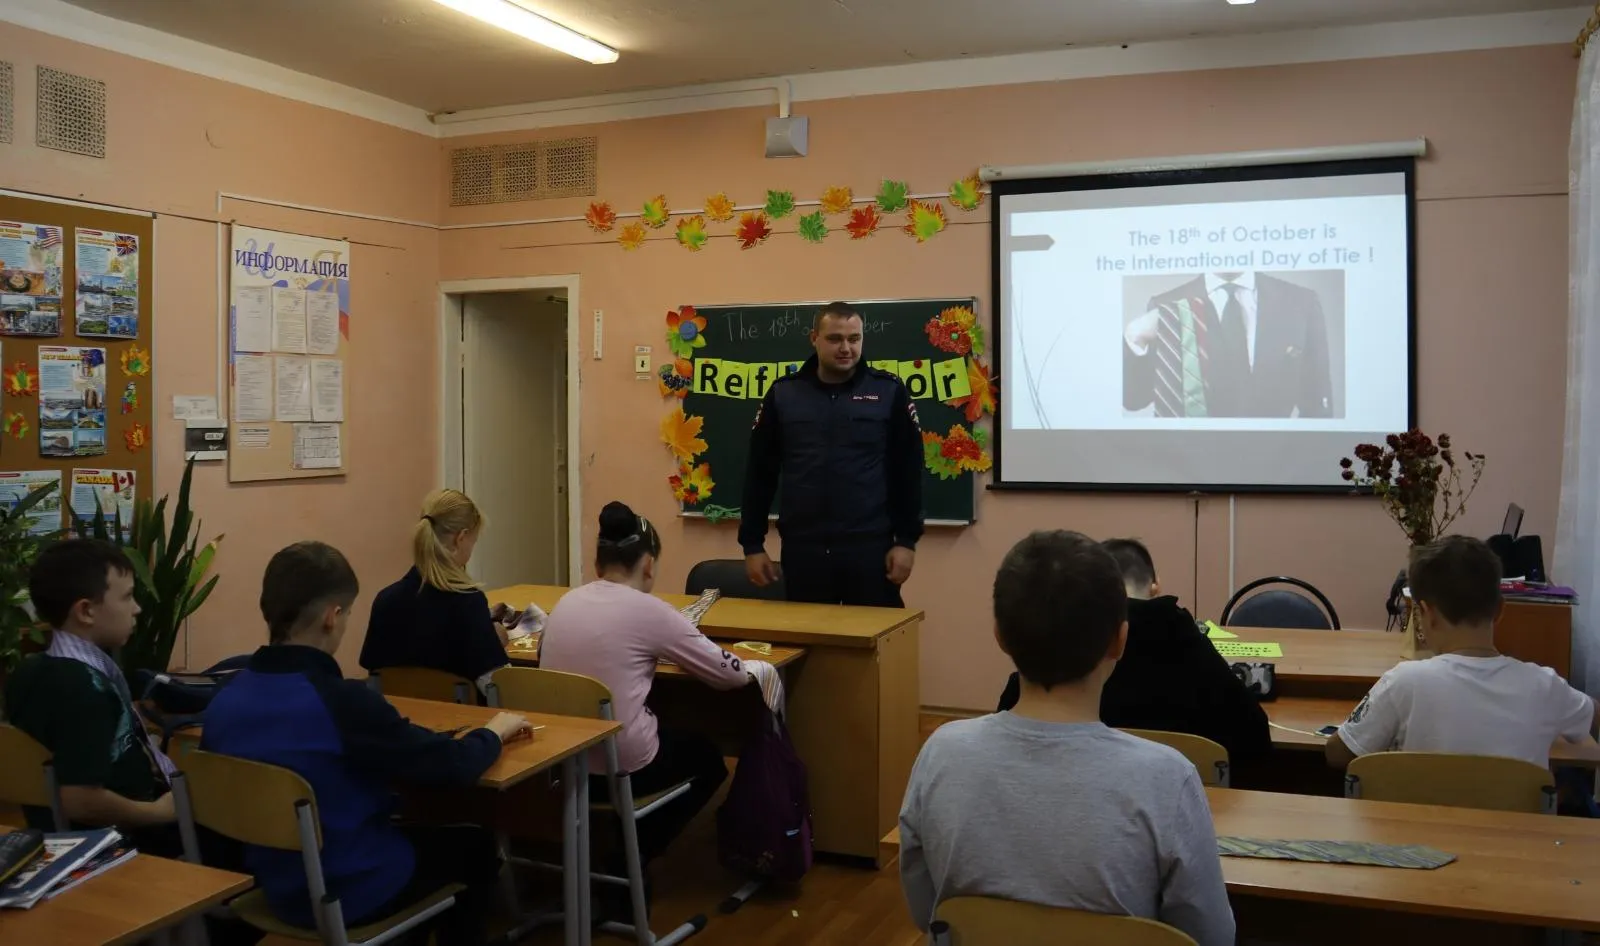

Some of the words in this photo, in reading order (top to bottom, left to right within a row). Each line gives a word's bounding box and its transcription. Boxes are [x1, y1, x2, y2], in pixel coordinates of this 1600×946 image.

[1128, 230, 1161, 247] The
[1168, 226, 1201, 245] 18th
[1207, 225, 1227, 243] of
[1232, 224, 1316, 243] October
[1323, 223, 1337, 239] is
[234, 249, 348, 278] ИНФОРМАЦИЯ
[1096, 255, 1126, 271] the
[1132, 249, 1255, 270] International
[1261, 248, 1302, 269] Day
[1308, 247, 1328, 265] of
[1333, 246, 1361, 264] Tie
[722, 310, 759, 342] The
